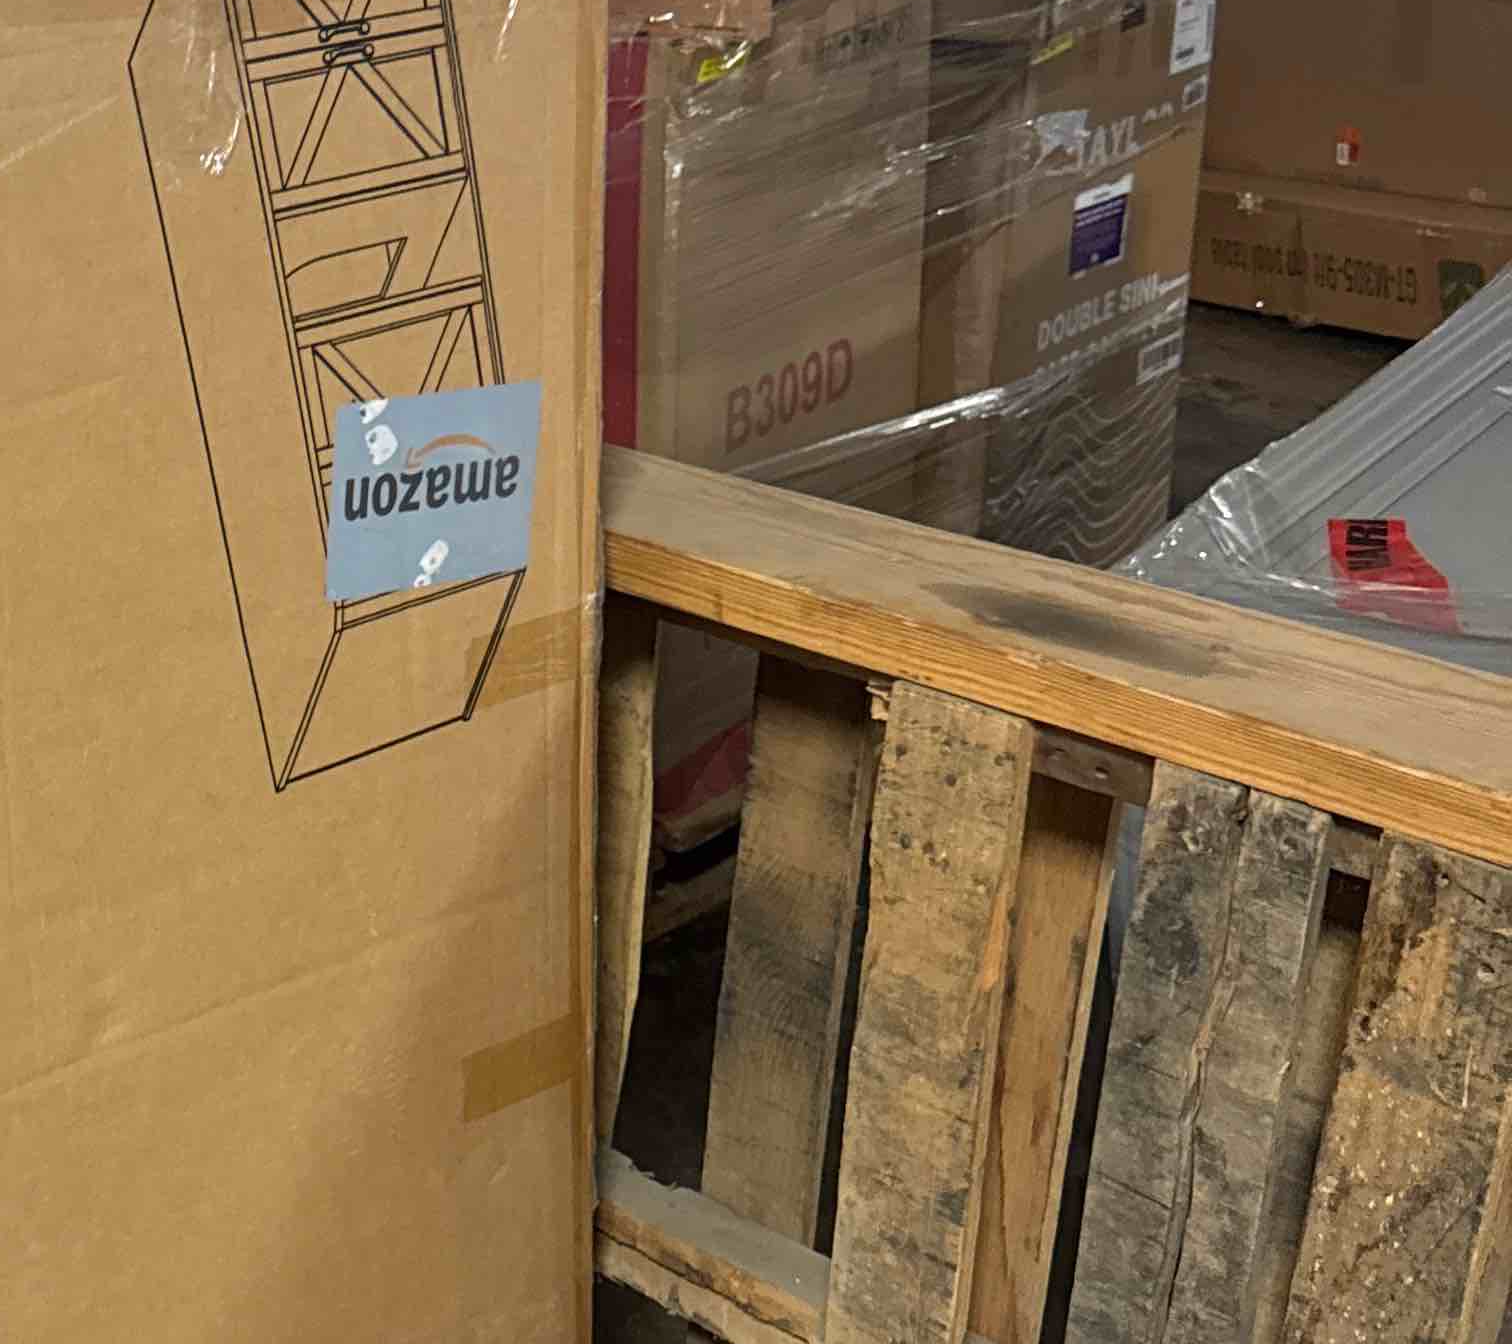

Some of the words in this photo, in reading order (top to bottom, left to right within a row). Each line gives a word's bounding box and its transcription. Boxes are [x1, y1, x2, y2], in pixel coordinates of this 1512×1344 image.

[1037, 290, 1117, 351] DOUBLE
[726, 338, 854, 453] B309D
[342, 453, 522, 522] amazon
